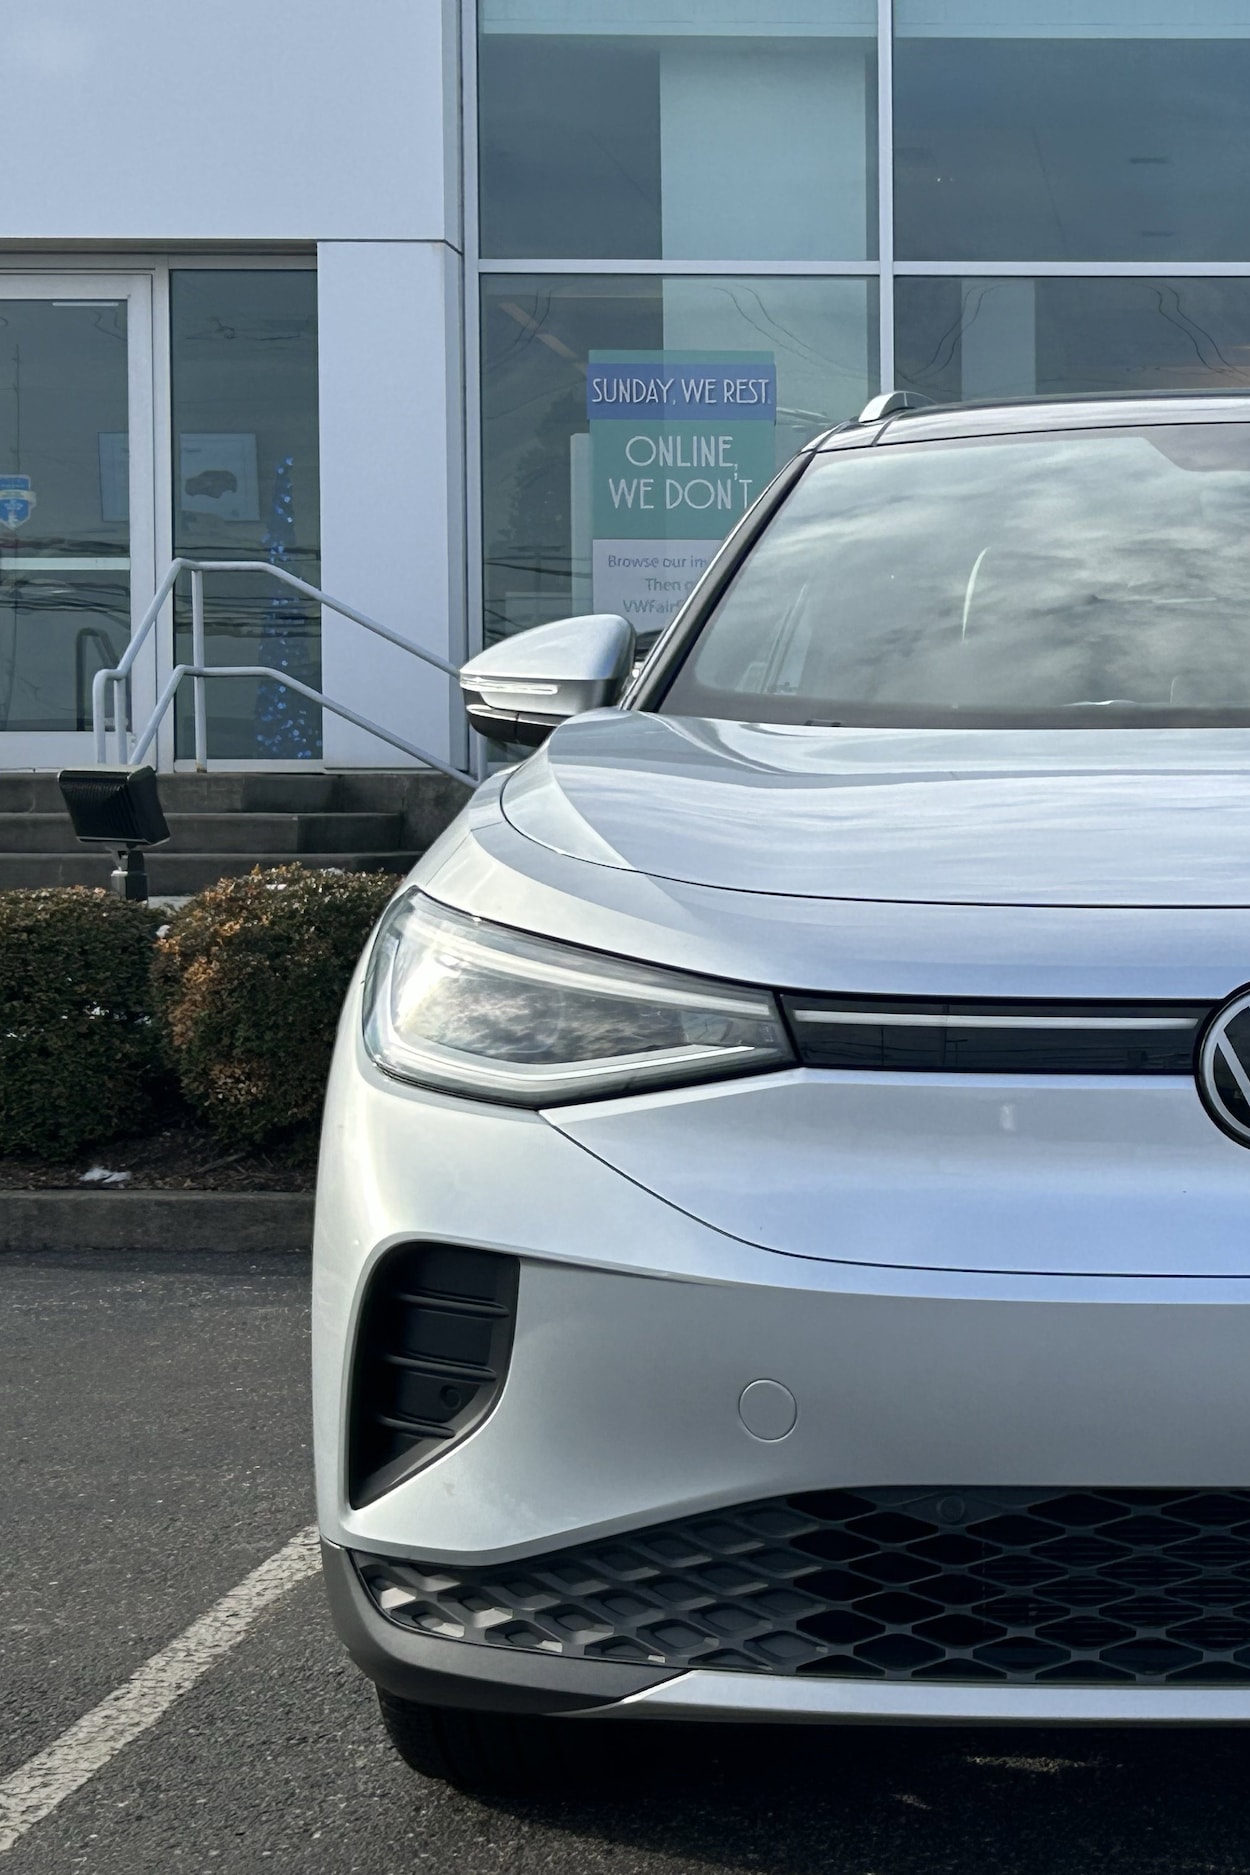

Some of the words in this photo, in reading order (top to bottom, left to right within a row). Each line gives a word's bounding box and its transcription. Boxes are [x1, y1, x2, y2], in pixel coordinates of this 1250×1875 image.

[591, 378, 676, 405] SUNDAY,
[681, 378, 717, 404] WE
[625, 435, 739, 471] ONLINE,
[608, 478, 654, 510] WE
[666, 473, 753, 510] DON'T
[607, 554, 659, 568] Browse
[662, 558, 686, 568] our
[645, 577, 681, 592] Then
